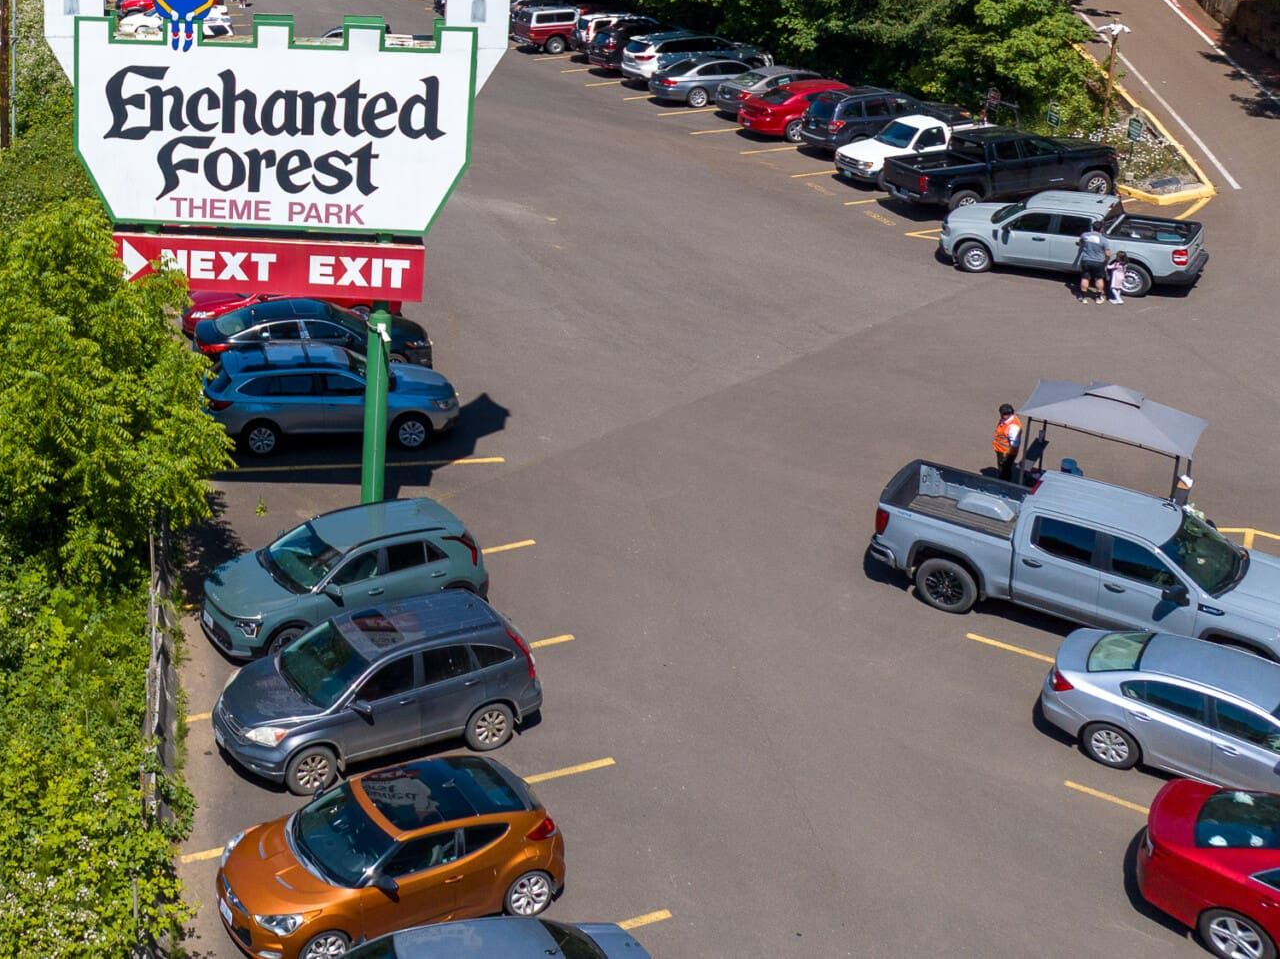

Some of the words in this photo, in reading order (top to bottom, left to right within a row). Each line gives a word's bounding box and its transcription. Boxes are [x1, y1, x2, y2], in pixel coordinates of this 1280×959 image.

[103, 64, 446, 141] Enchanted
[155, 135, 380, 201] Forest
[169, 197, 271, 221] THEME
[287, 202, 365, 225] PARK
[160, 248, 277, 282] NEXT
[308, 255, 411, 289] EXIT
